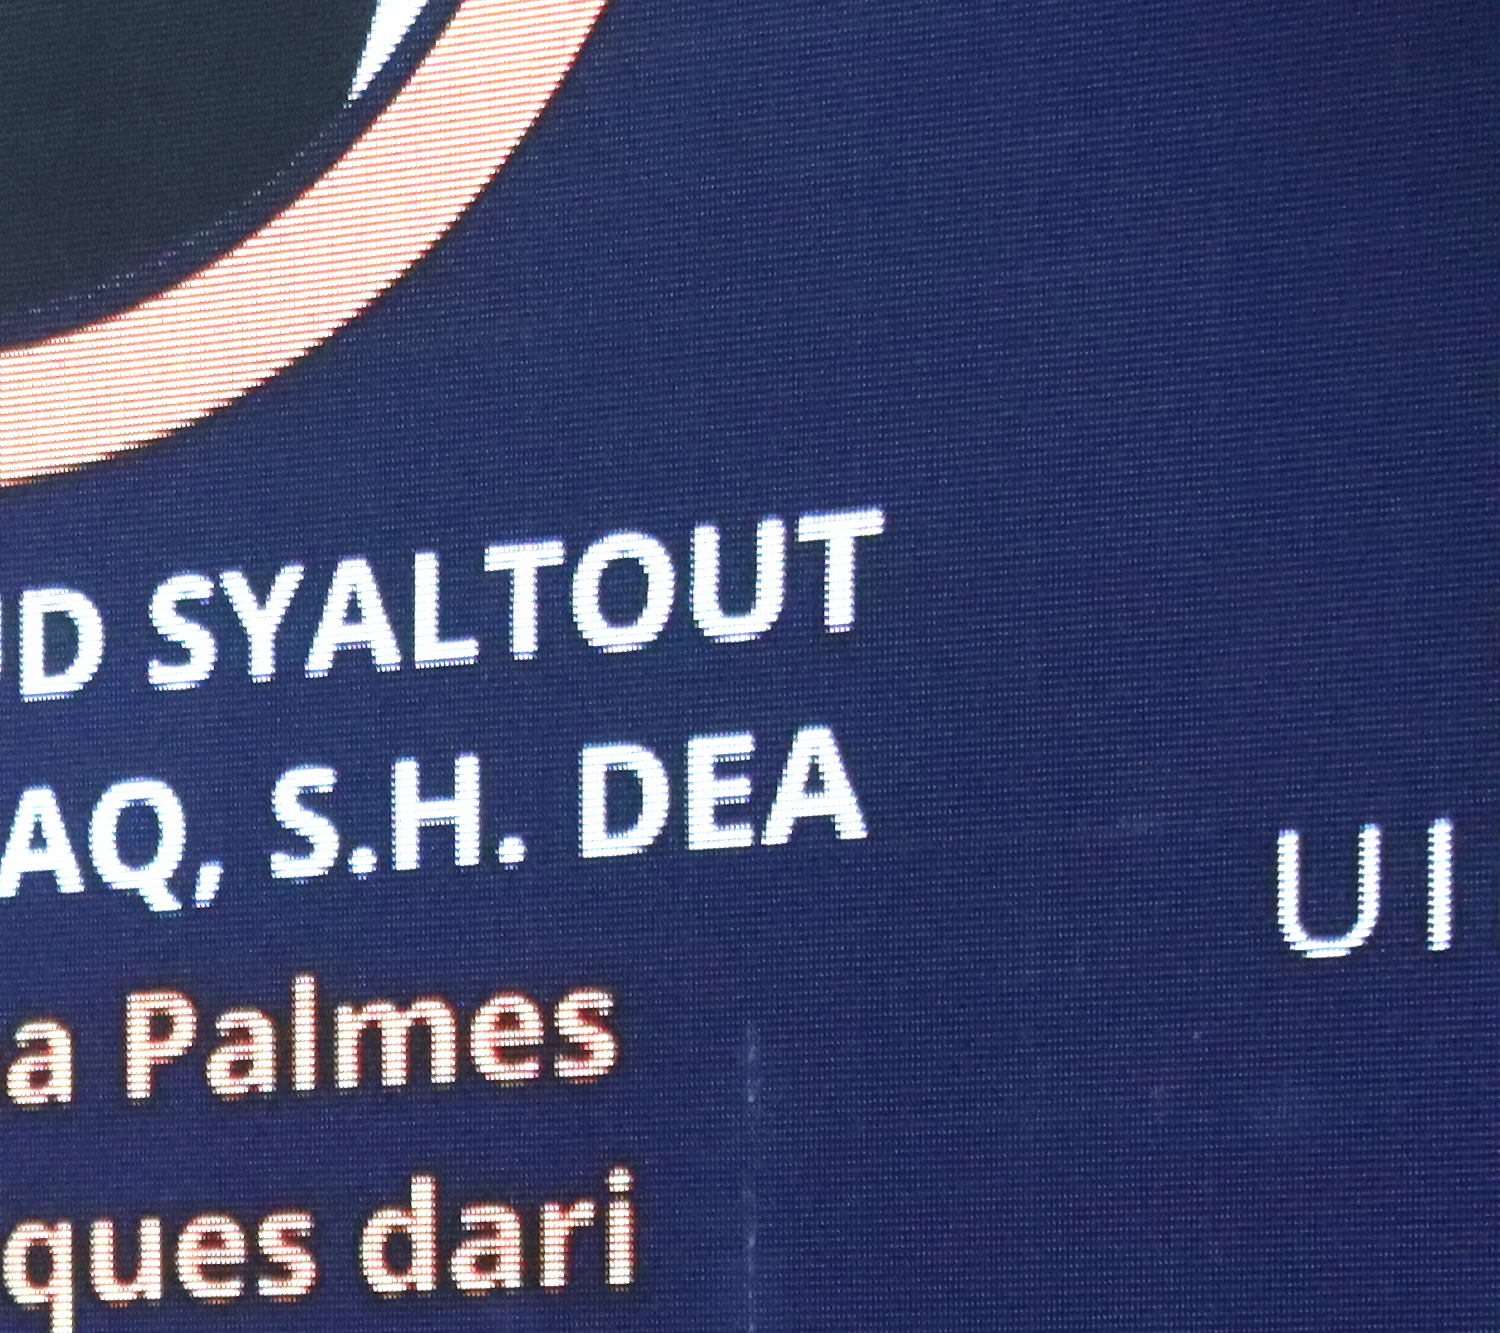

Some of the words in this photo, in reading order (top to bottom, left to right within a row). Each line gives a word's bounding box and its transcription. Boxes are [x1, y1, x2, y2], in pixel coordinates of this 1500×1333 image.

[146, 506, 887, 693] SYALTOUT
[269, 751, 527, 886] S.H.
[577, 724, 869, 860] DEA
[125, 973, 619, 1102] Palmes
[358, 1167, 635, 1300] dari
